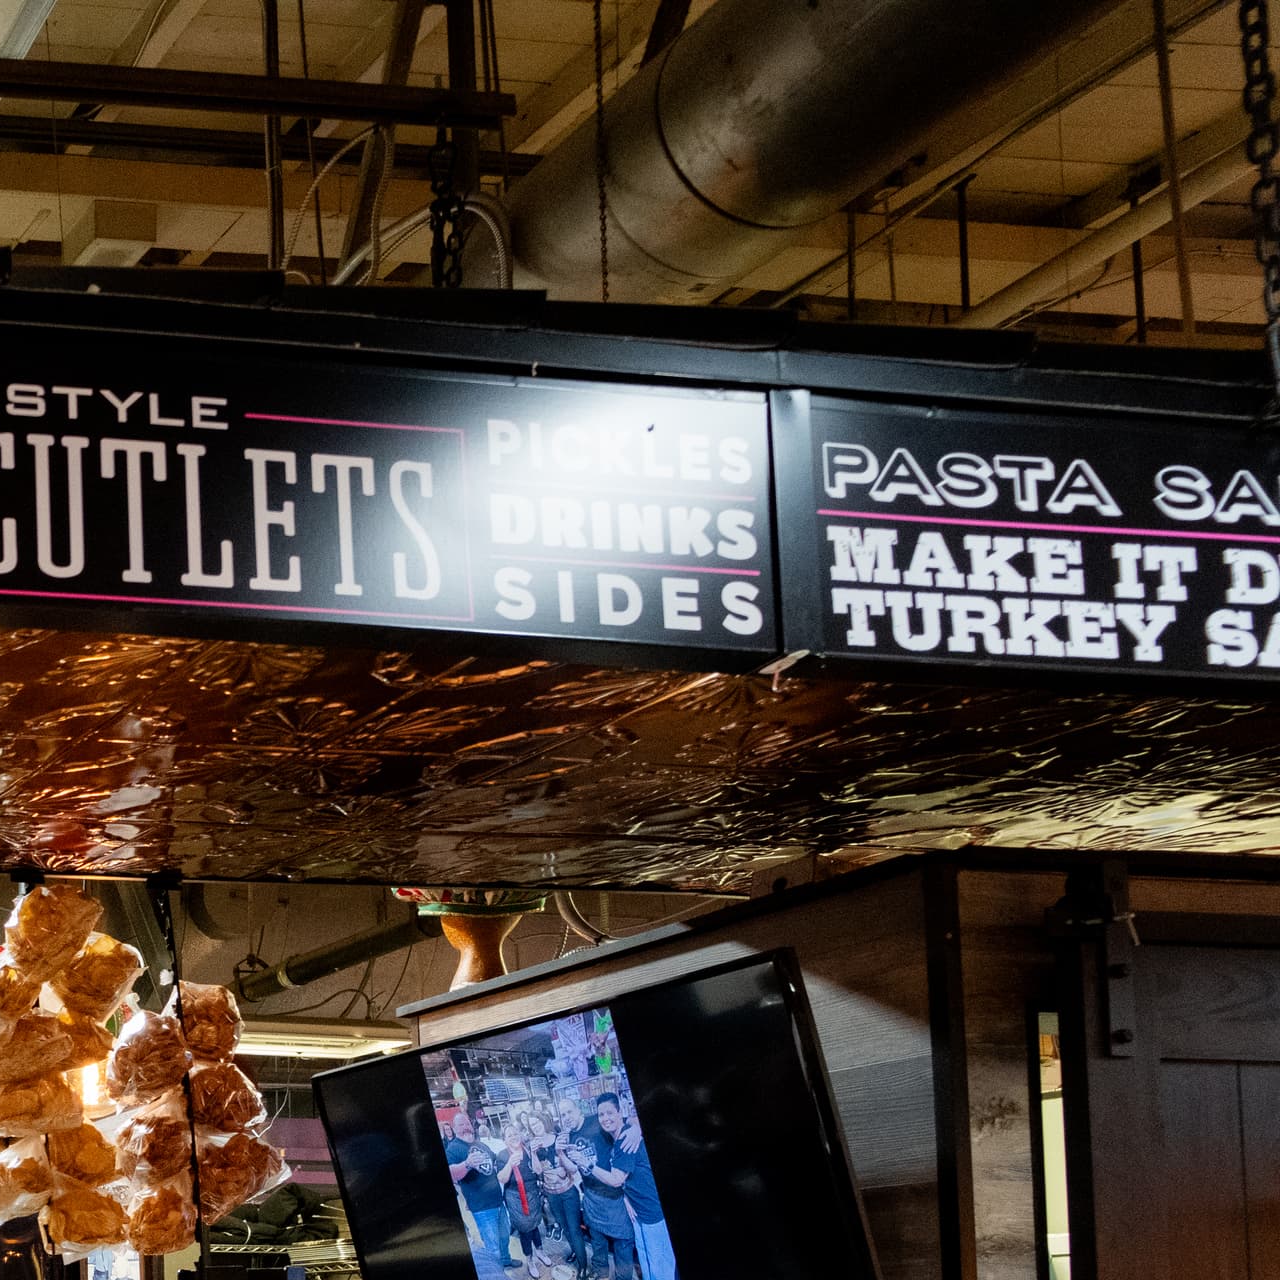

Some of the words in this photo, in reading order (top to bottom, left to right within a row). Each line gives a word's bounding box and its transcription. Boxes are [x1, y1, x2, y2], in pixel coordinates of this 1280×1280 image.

[5, 384, 229, 431] STYLE
[487, 419, 753, 485] PICKLES
[822, 442, 1123, 518] PASTA
[1153, 465, 1280, 526] SA
[489, 492, 757, 561] DRINKS
[826, 525, 1085, 595] MAKE
[1111, 542, 1197, 602] IT
[494, 567, 763, 636] SIDES
[832, 587, 1176, 662] TURKEY
